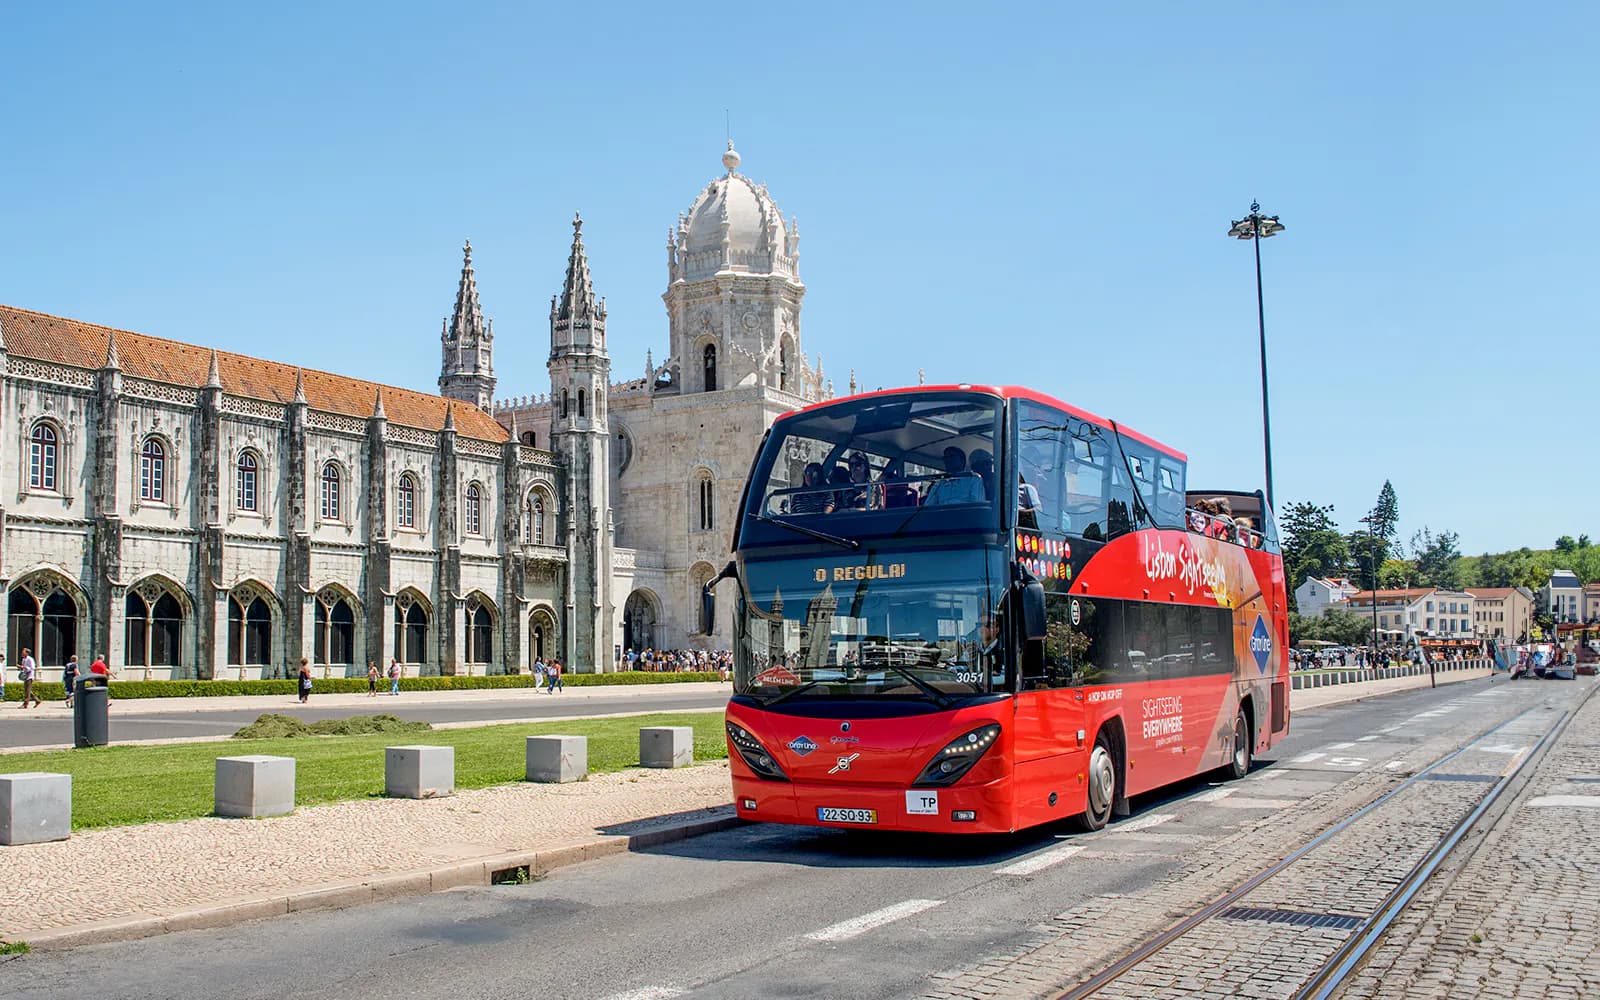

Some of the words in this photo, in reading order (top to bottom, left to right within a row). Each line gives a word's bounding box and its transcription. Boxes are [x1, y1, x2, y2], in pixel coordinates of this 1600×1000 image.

[1144, 533, 1176, 582] Lisbon
[1179, 543, 1227, 599] Sightseeing
[956, 672, 984, 683] 3051
[1142, 696, 1183, 719] SIGHTSEEING
[1142, 716, 1183, 739] EVERYWHERE
[920, 797, 937, 808] TP
